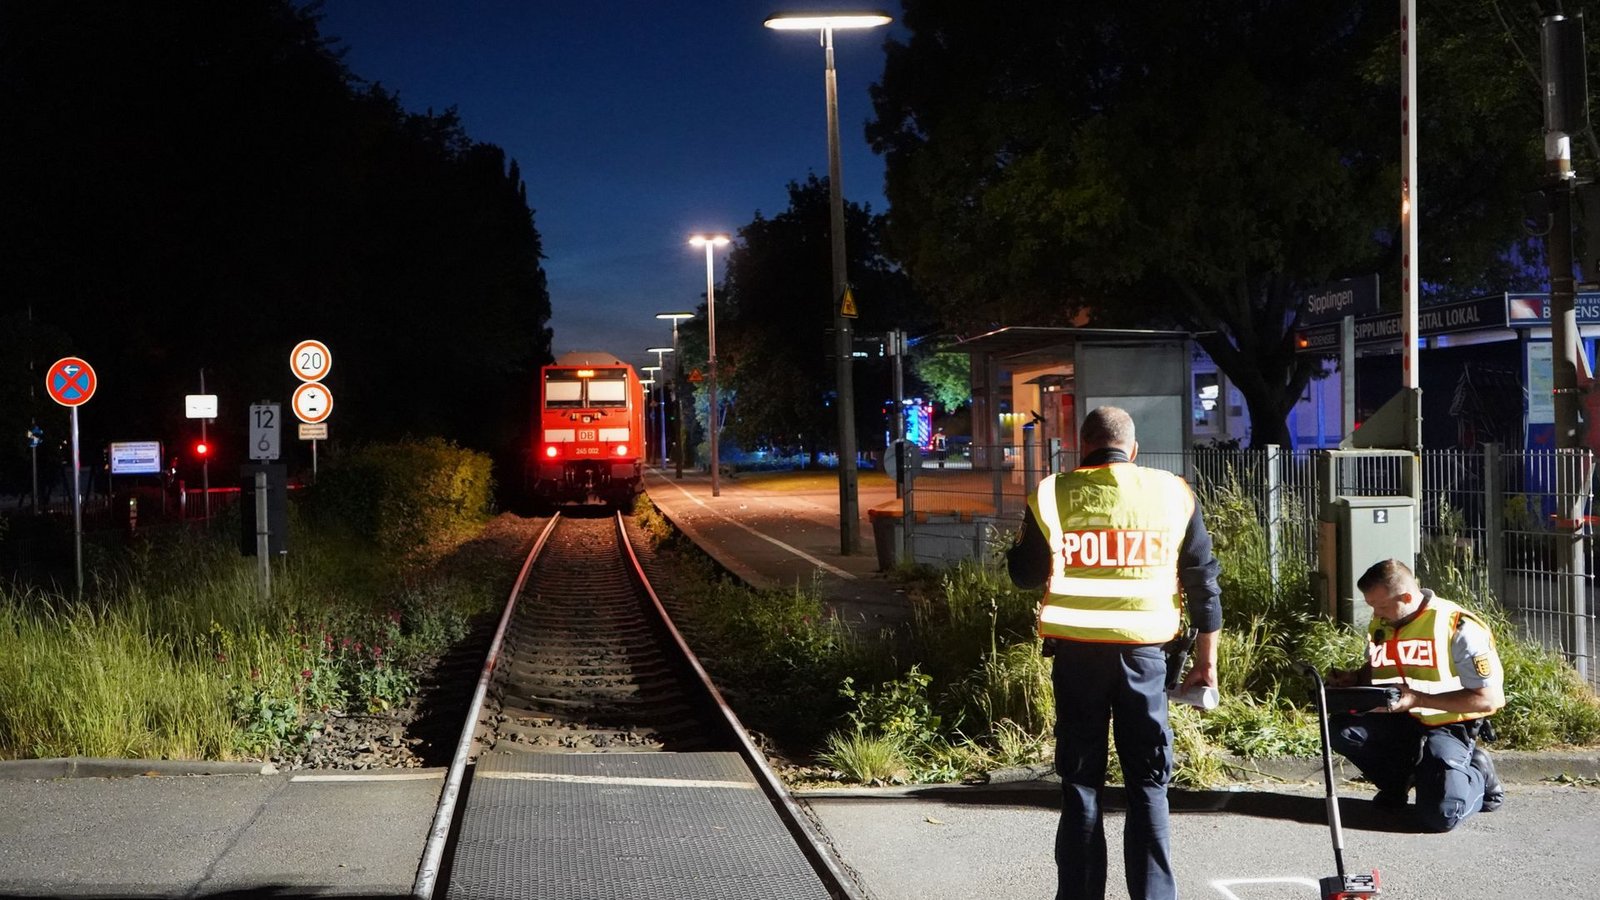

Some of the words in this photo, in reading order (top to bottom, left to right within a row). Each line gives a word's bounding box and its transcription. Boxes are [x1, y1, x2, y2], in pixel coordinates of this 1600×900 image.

[1308, 290, 1353, 314] Sipplingen
[1418, 311, 1443, 331] GITAL
[1446, 305, 1480, 327] LOKAL
[1543, 305, 1600, 319] BENS
[301, 352, 322, 370] 20
[254, 409, 274, 429] 12
[257, 433, 270, 452] 6
[580, 431, 594, 440] DB
[1376, 510, 1385, 523] 2
